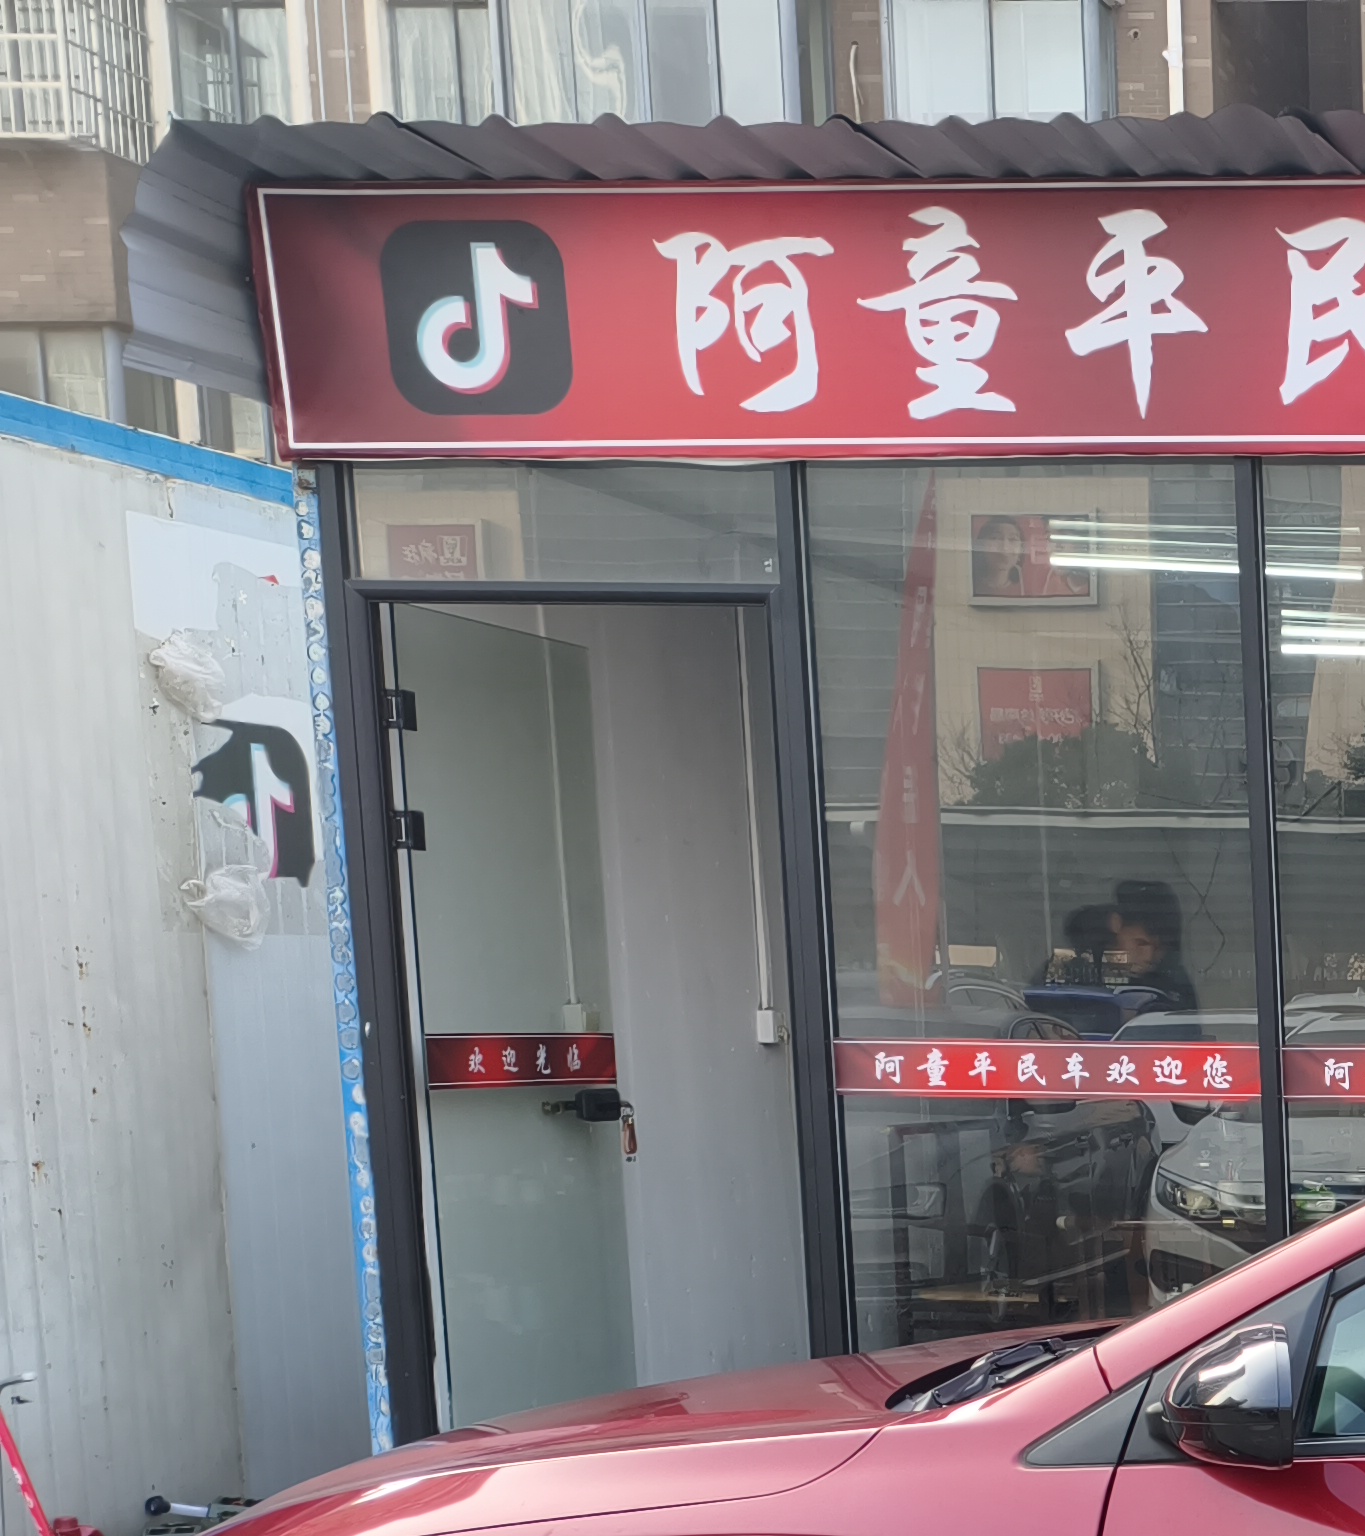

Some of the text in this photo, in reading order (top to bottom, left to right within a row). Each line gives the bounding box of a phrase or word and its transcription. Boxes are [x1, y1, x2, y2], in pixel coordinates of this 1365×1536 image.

[468, 1041, 582, 1076] 欢迎光临
[874, 1045, 1235, 1089] 阿童平民车欢迎您
